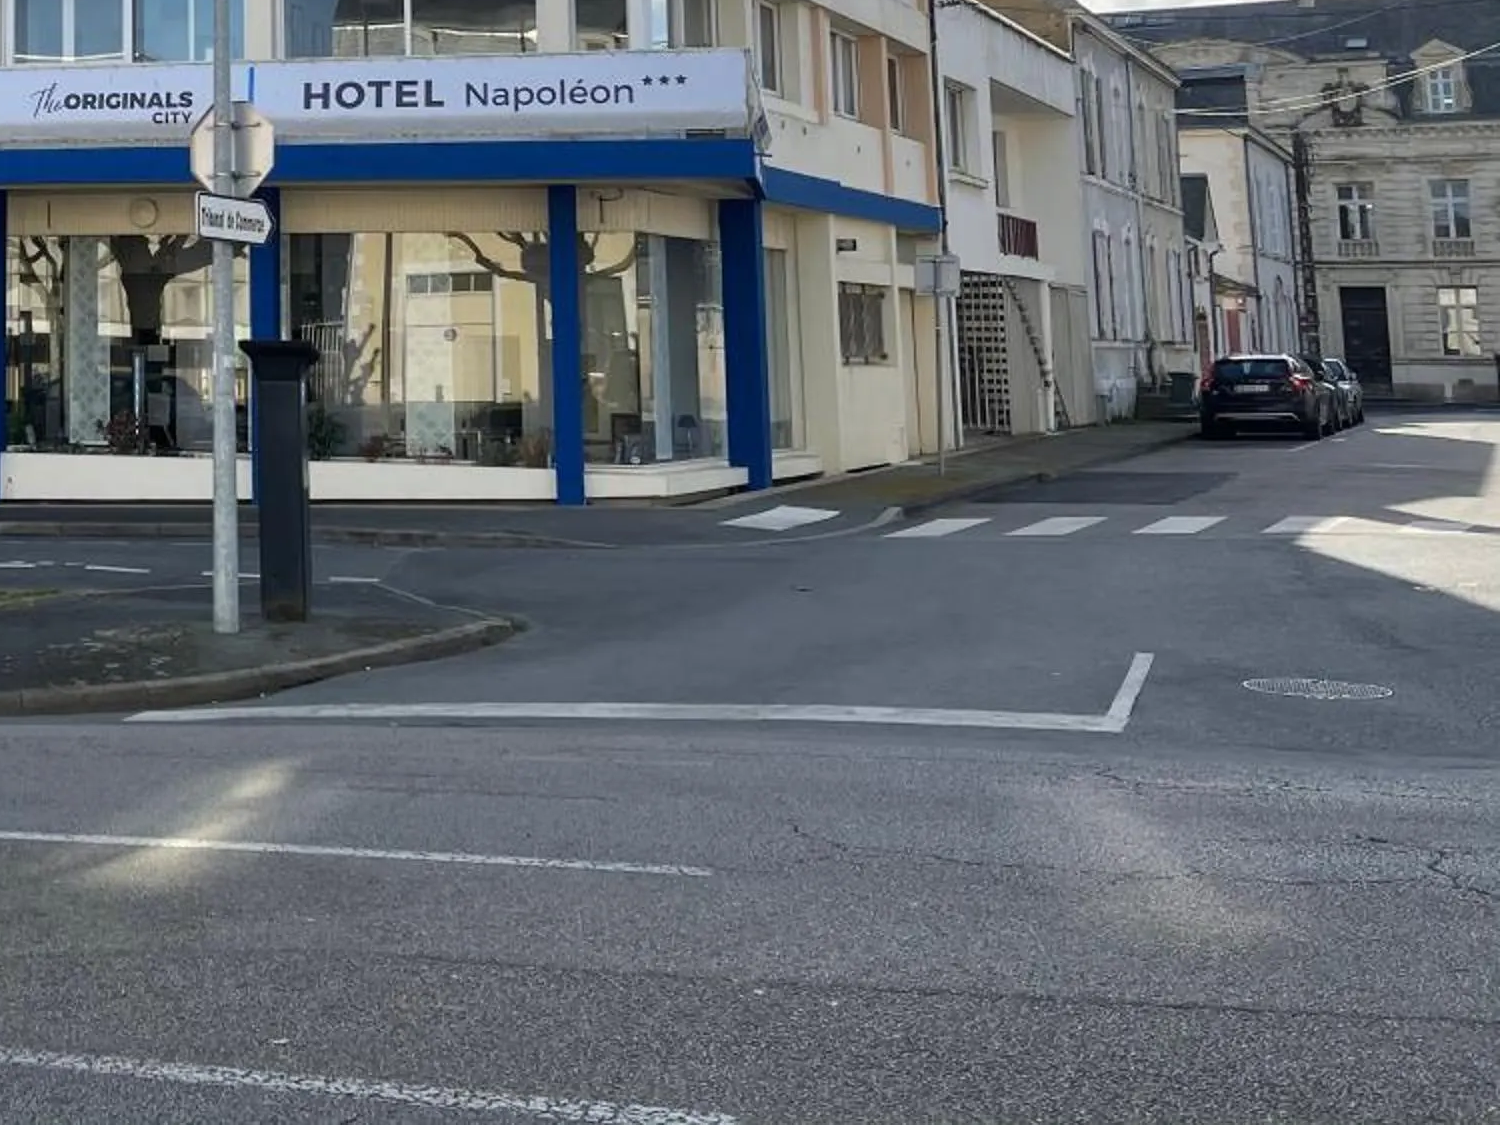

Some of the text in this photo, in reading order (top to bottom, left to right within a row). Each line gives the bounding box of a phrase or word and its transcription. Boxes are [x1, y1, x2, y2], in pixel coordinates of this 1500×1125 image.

[64, 91, 193, 111] ORIGINALS
[303, 79, 634, 112] HOTEL Napoléon
[152, 111, 193, 124] CITY
